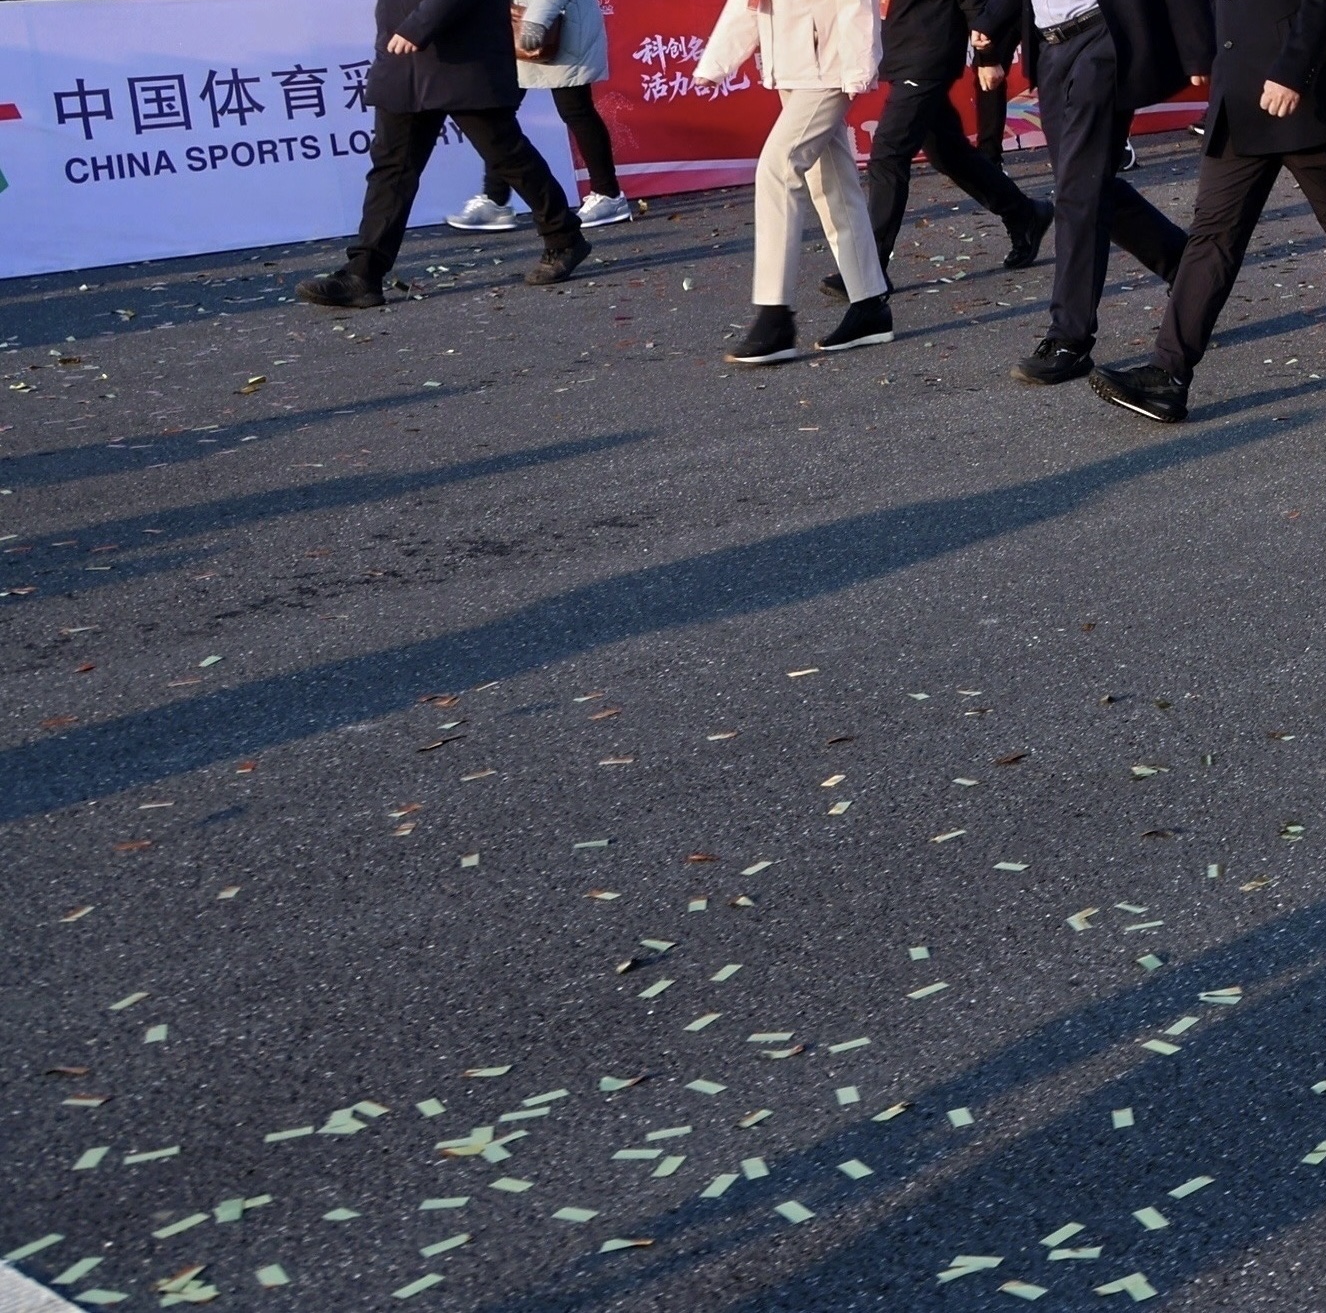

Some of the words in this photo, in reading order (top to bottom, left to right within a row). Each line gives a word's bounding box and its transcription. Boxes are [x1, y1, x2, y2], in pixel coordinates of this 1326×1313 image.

[633, 34, 708, 75] 科创名
[64, 147, 177, 185] CHINA
[186, 135, 322, 173] SPORTS
